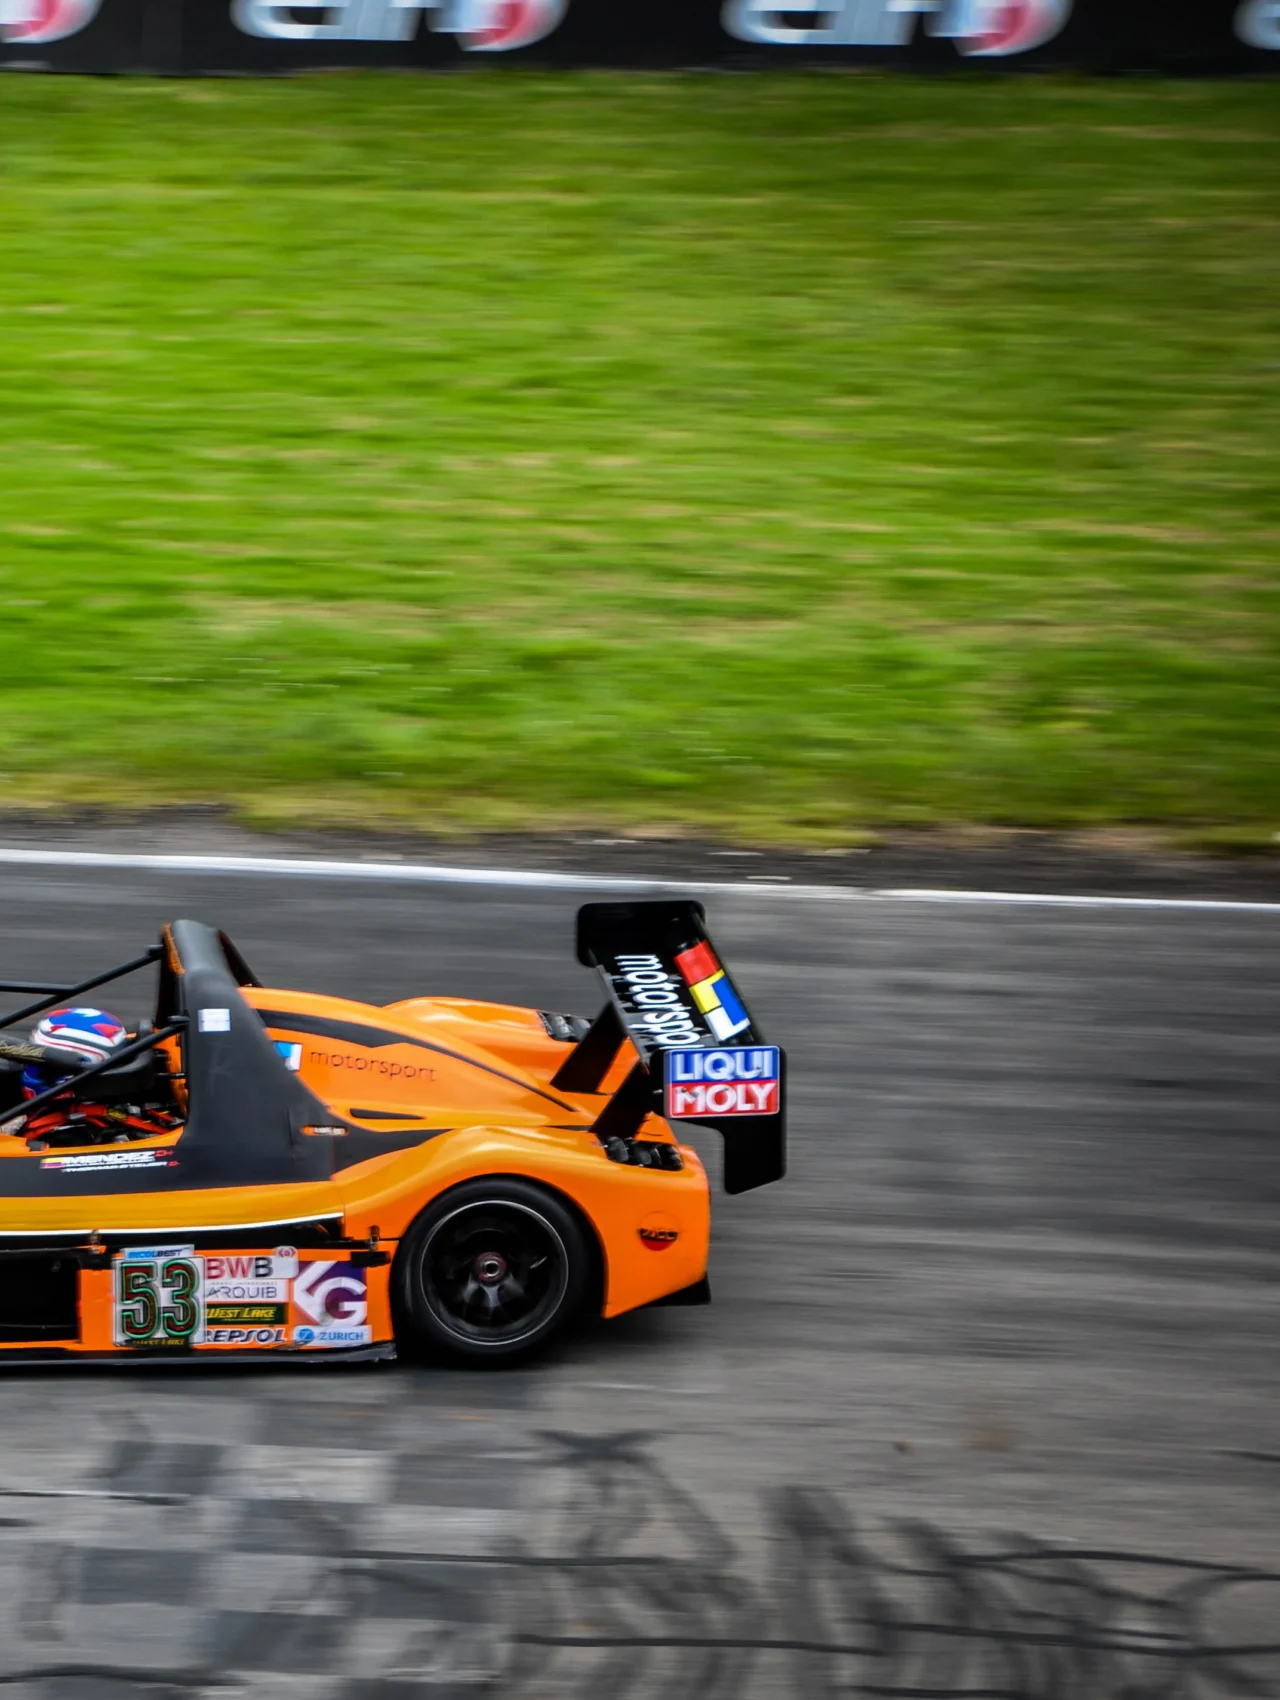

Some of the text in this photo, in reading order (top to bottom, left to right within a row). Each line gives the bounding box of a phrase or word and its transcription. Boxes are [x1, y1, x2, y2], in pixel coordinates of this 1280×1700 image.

[310, 1050, 437, 1081] motorsport
[675, 1050, 774, 1081] LIQUI
[674, 1082, 776, 1113] MOLY
[206, 1256, 274, 1279] BWB
[120, 1257, 200, 1340] 53
[242, 1306, 277, 1319] LAKE
[320, 1331, 364, 1341] ZURICH
